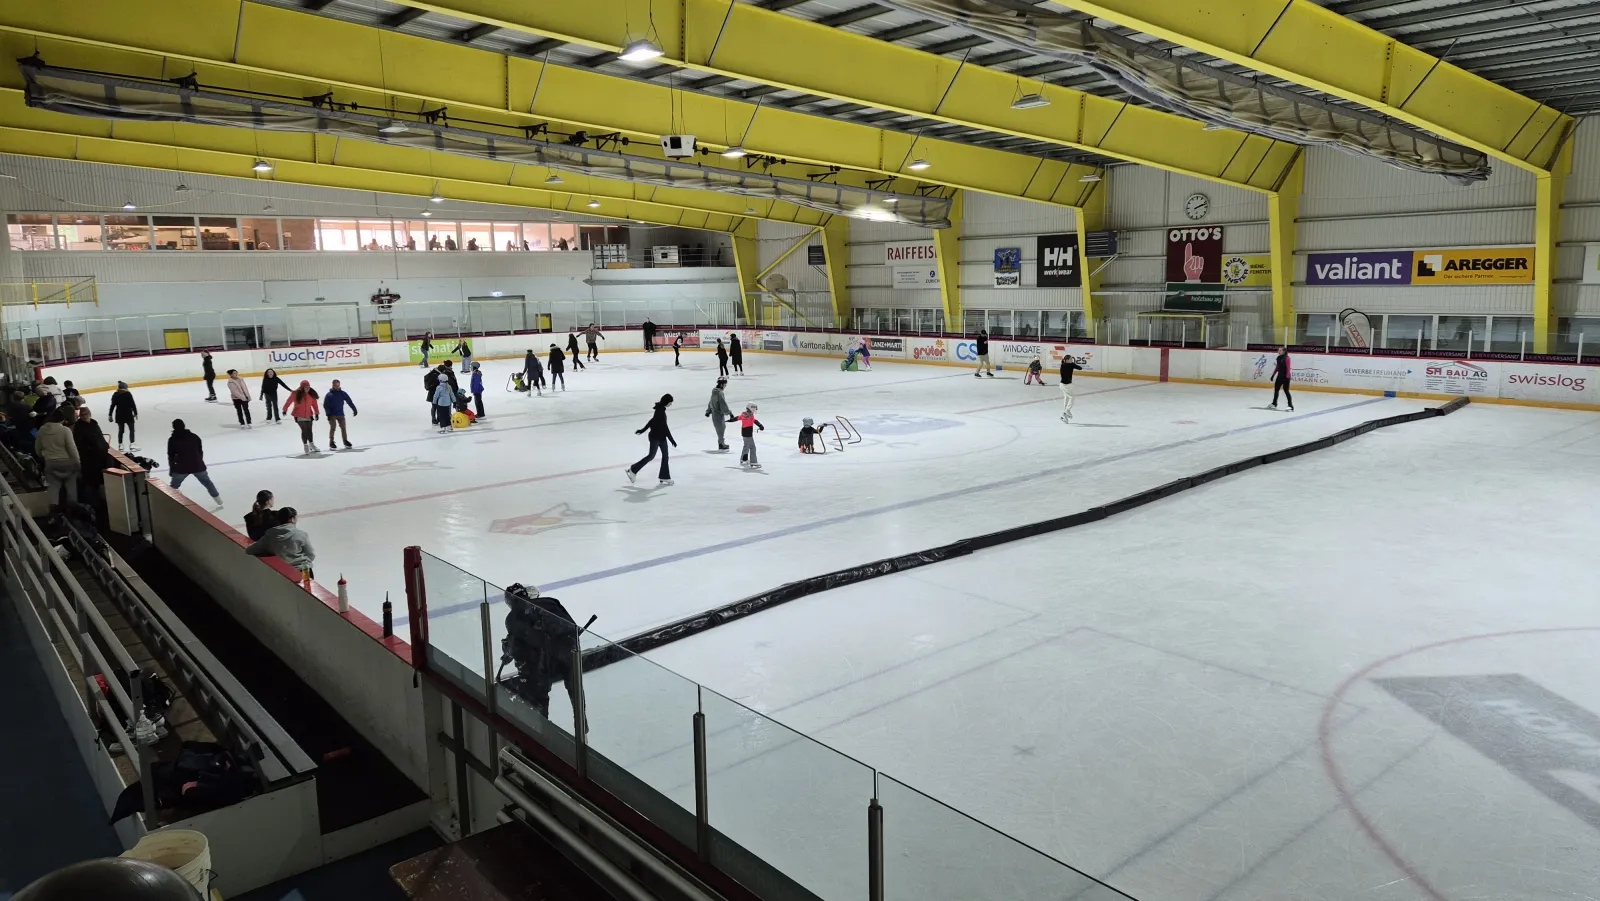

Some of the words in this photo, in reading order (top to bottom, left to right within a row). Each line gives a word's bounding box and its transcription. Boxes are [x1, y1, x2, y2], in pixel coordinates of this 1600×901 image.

[1170, 227, 1221, 242] OTTO'S
[1315, 257, 1402, 280] valiant
[1444, 258, 1528, 271] AREGGER
[800, 341, 843, 351] Kantonalbank
[1003, 344, 1040, 354] WINDGATE
[1508, 372, 1586, 391] swisslog
